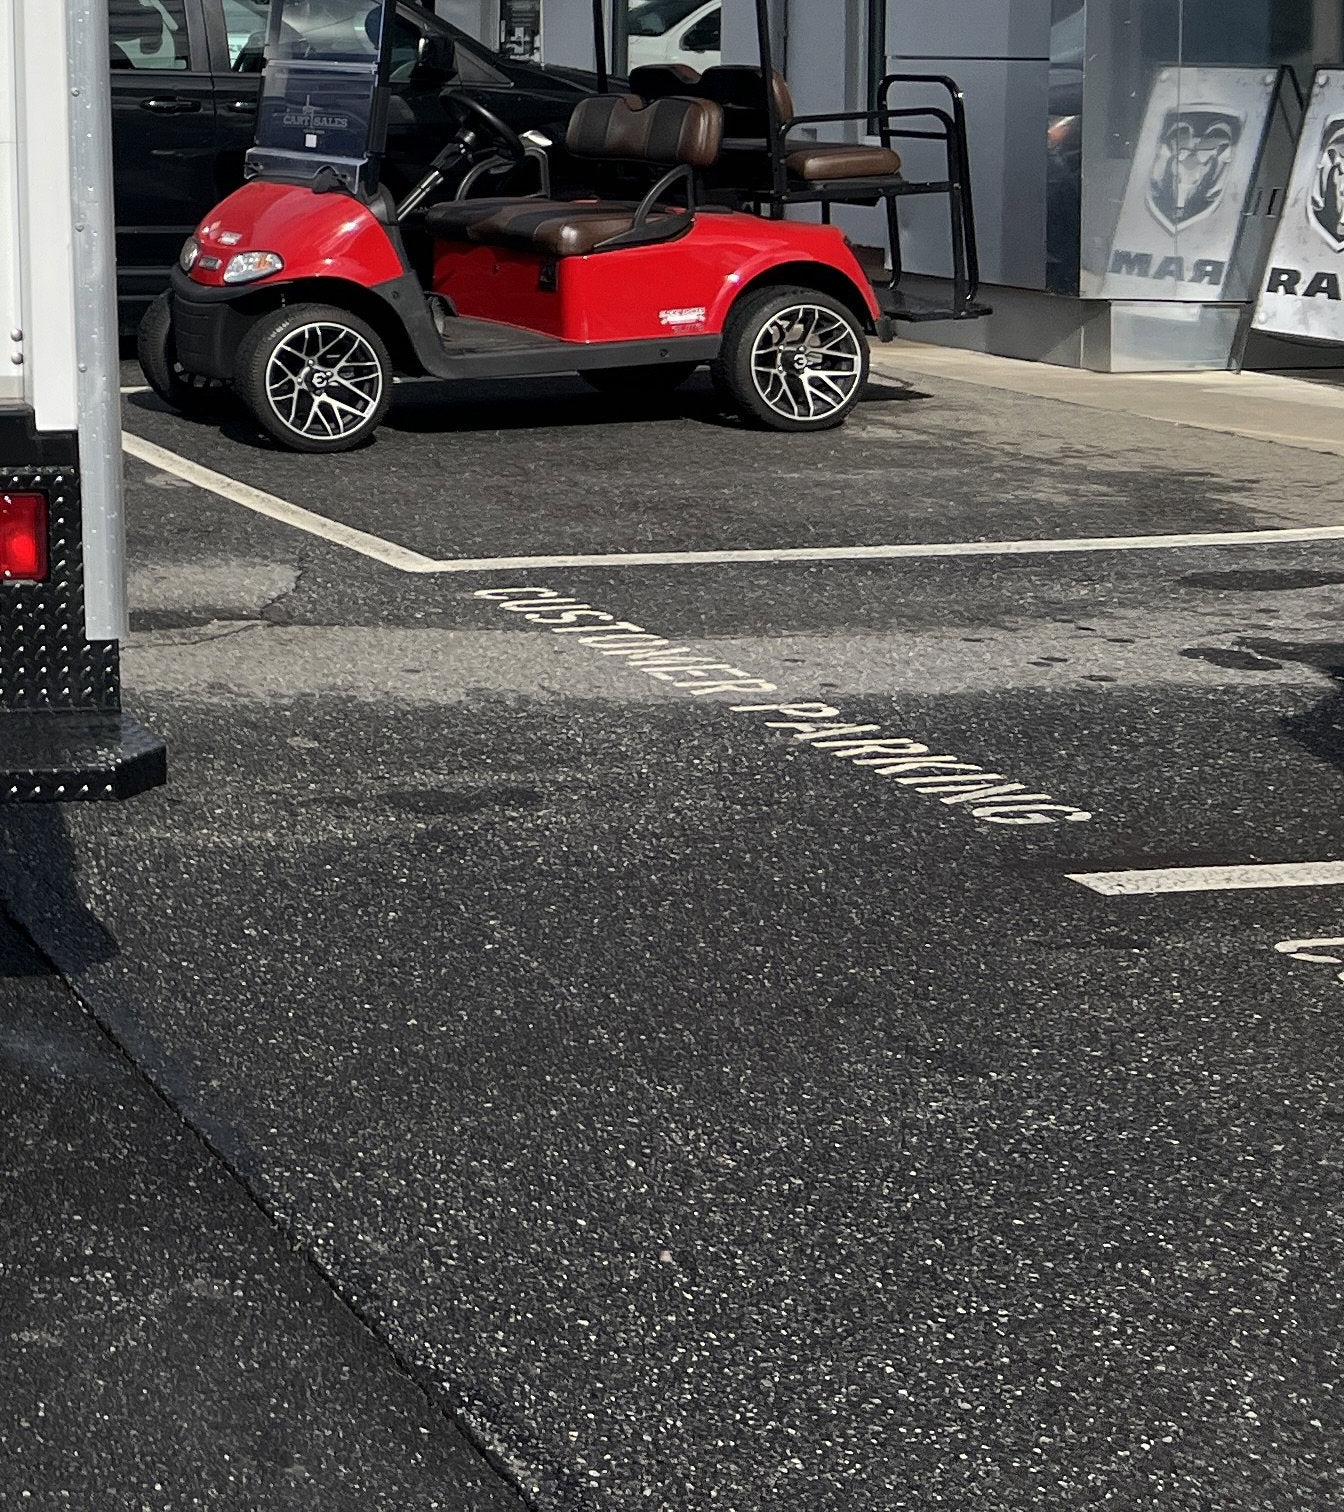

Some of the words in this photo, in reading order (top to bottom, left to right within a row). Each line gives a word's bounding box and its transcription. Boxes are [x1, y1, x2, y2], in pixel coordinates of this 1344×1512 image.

[283, 115, 310, 126] CART
[473, 587, 778, 696] CUSTOMER
[729, 702, 1092, 825] PARKING
